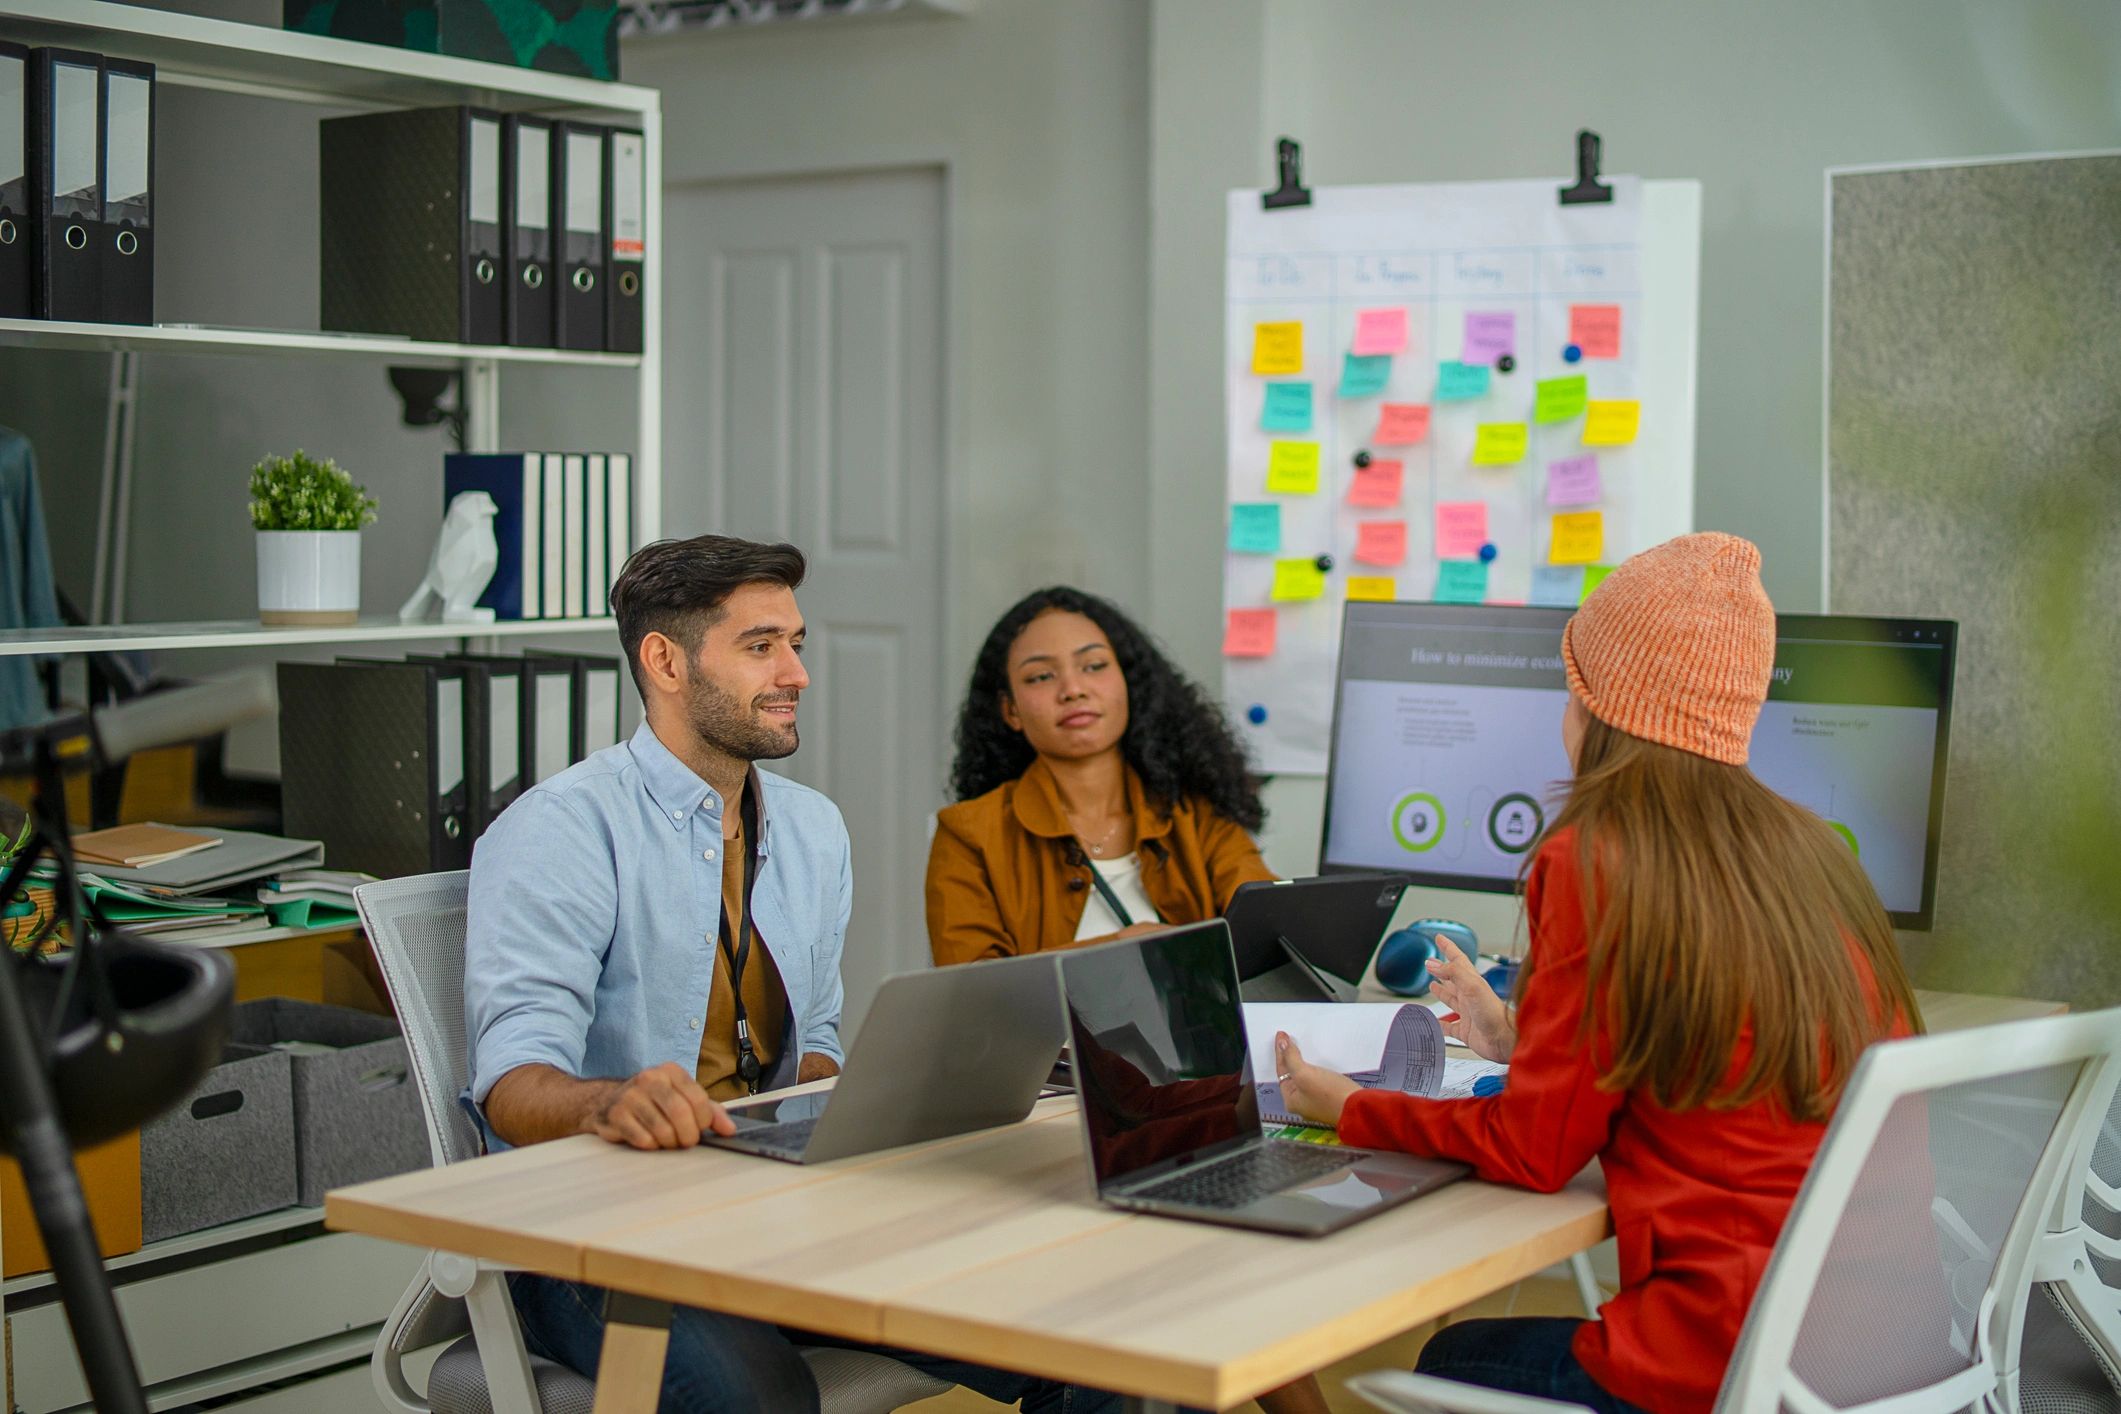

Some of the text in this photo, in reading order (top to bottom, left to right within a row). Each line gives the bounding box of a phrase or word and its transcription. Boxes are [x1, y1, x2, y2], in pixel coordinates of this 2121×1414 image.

[1411, 647, 1442, 664] How
[1446, 651, 1462, 666] to
[1464, 651, 1529, 668] minimize
